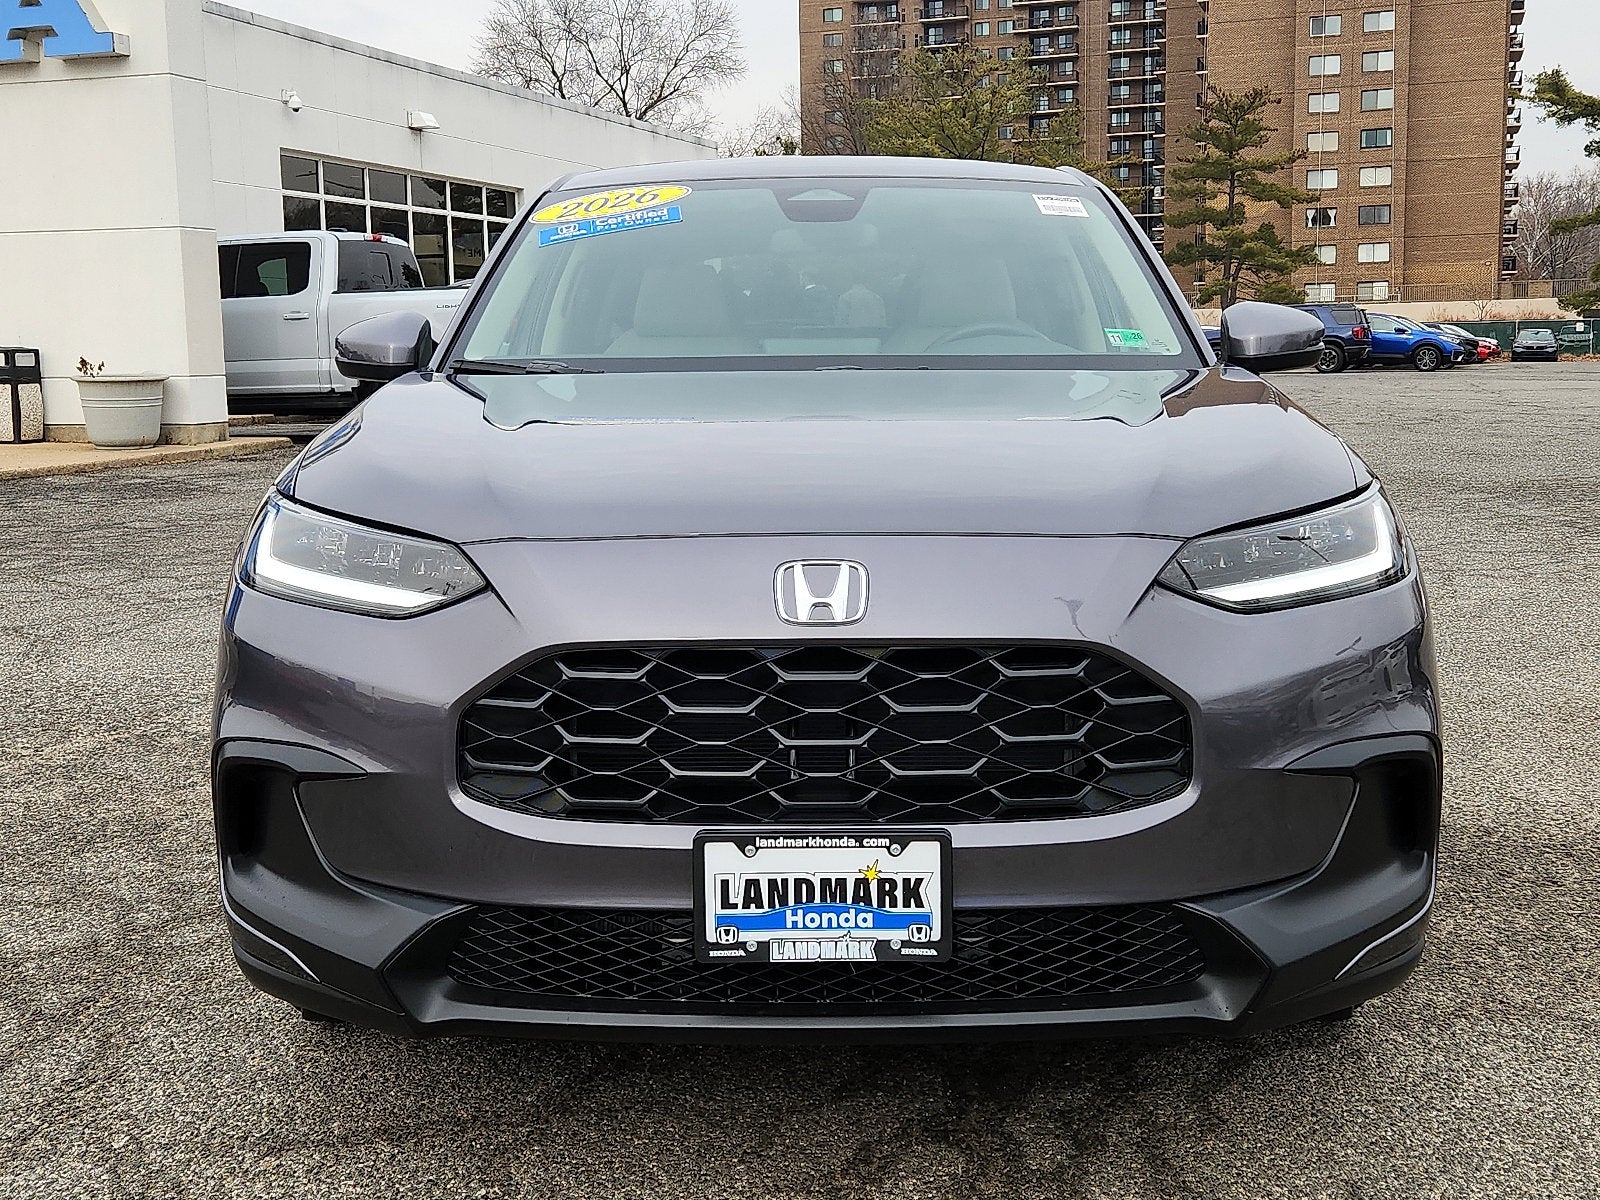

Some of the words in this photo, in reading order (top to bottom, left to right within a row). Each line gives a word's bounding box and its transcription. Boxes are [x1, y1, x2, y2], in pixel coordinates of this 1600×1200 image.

[556, 188, 660, 219] 2026
[595, 207, 668, 226] Certified
[1110, 334, 1123, 343] 11
[719, 877, 927, 910] LANDMARK
[785, 908, 875, 929] Honda
[771, 939, 876, 961] LANDMARK
[900, 947, 939, 956] HONDA
